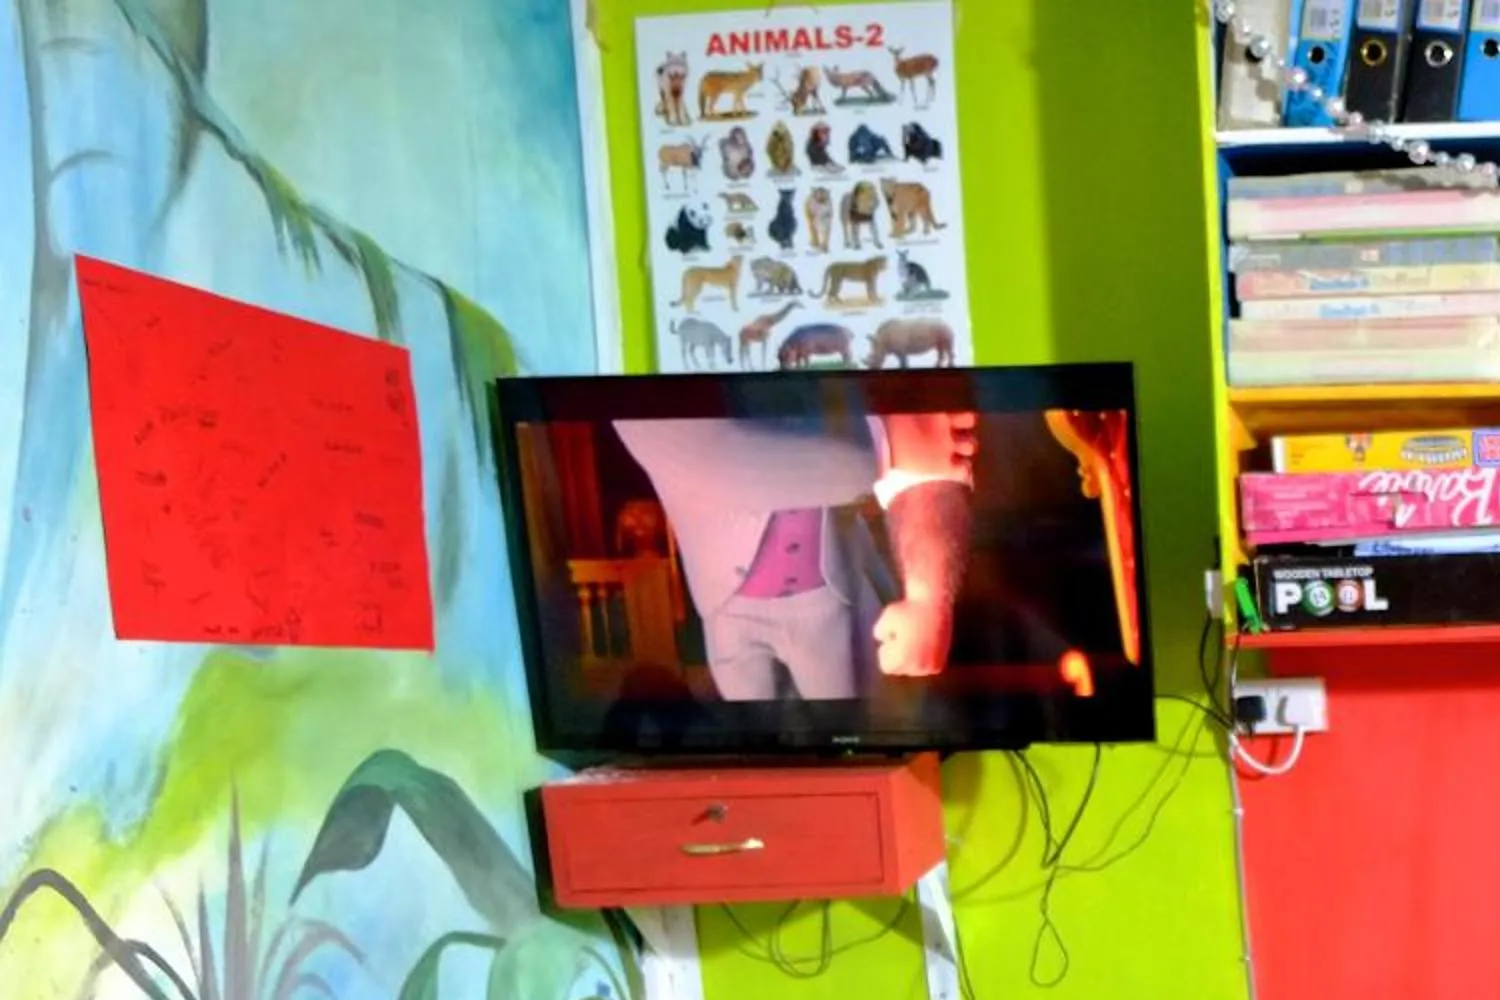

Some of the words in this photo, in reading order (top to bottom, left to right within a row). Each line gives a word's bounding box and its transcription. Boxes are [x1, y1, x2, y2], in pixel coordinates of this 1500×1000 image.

[706, 22, 885, 56] ANIMALS-2
[1272, 568, 1321, 579] WOODEN
[1321, 566, 1375, 578] TABLETOP
[1275, 578, 1390, 617] POOL
